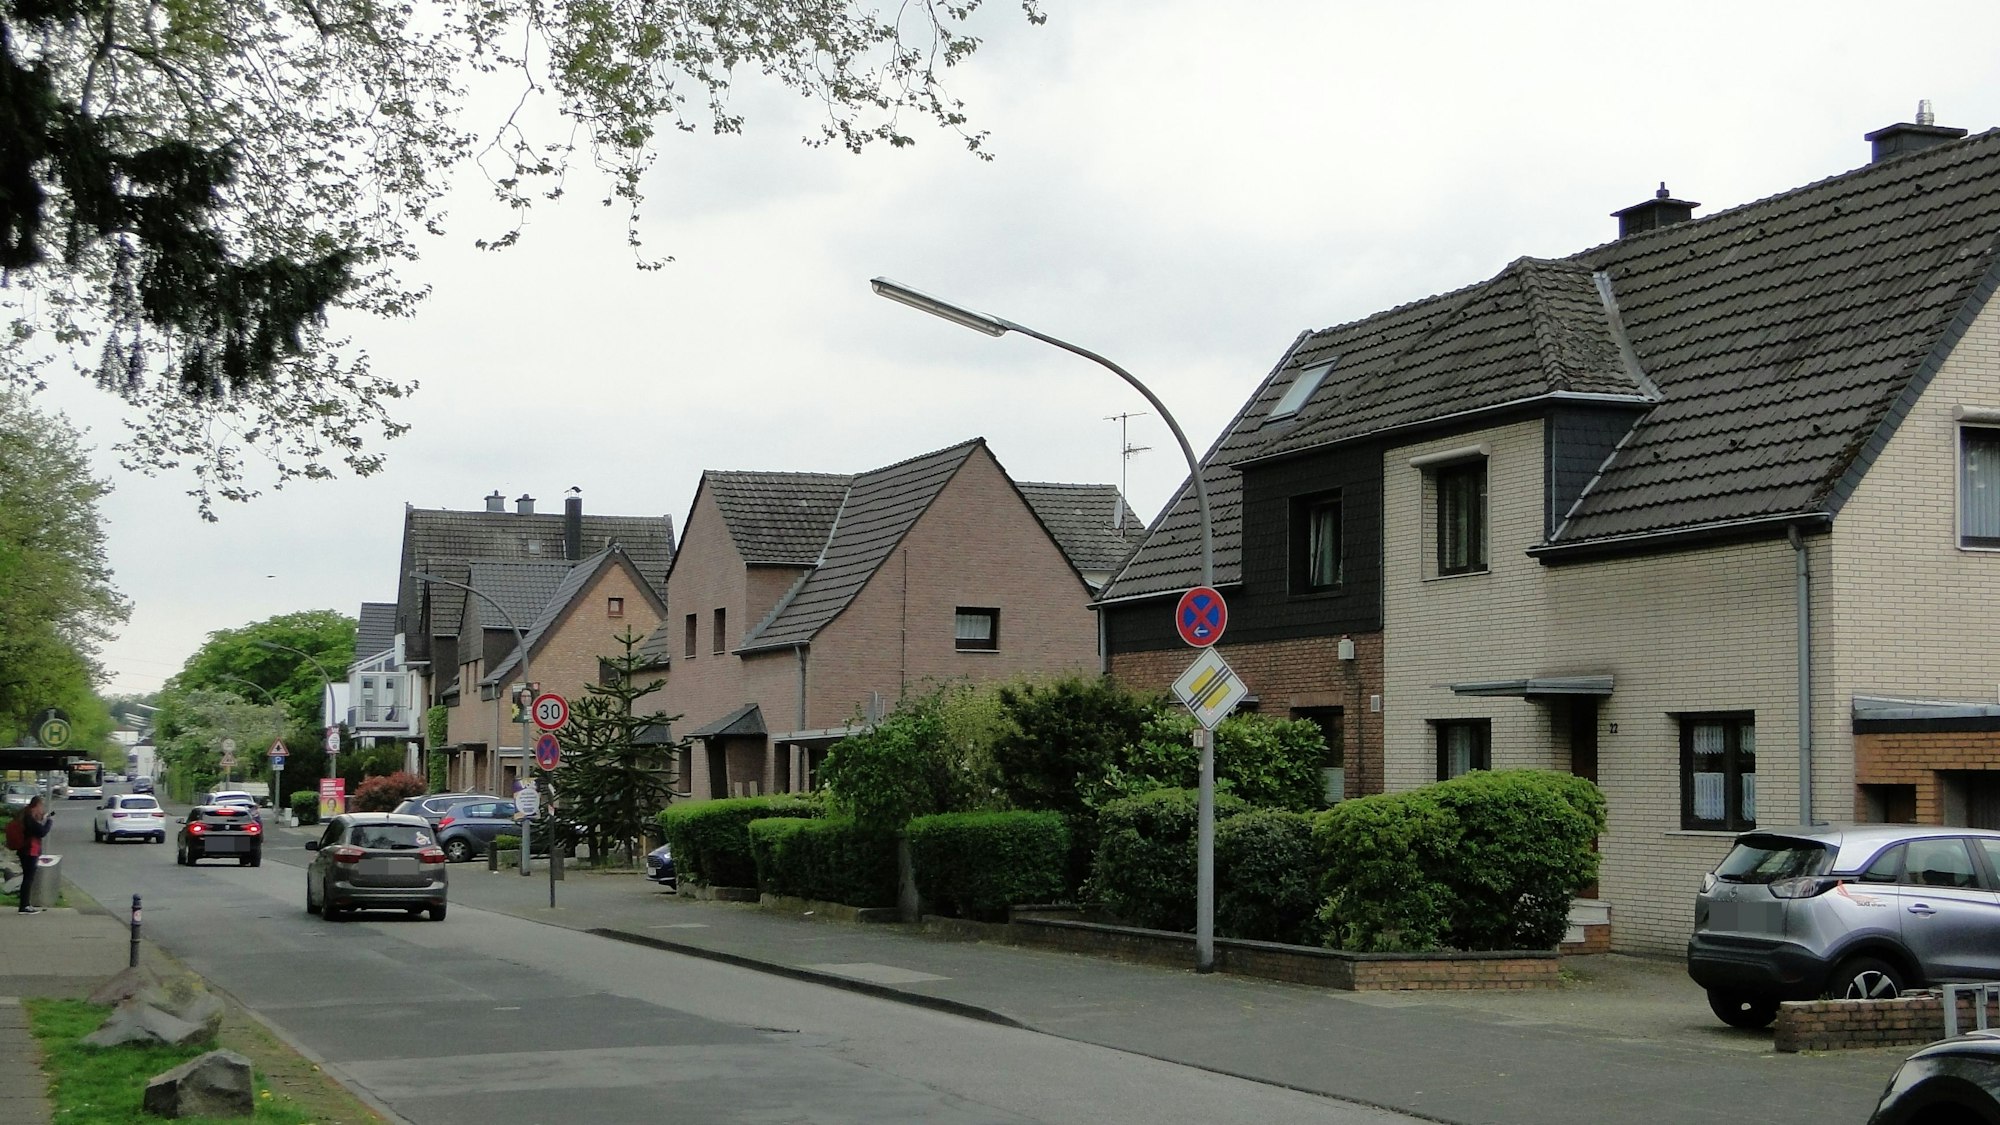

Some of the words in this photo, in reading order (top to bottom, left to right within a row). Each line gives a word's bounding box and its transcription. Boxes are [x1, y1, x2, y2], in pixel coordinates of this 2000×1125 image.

[540, 704, 560, 720] 30
[49, 726, 62, 741] H
[1610, 723, 1618, 733] 22
